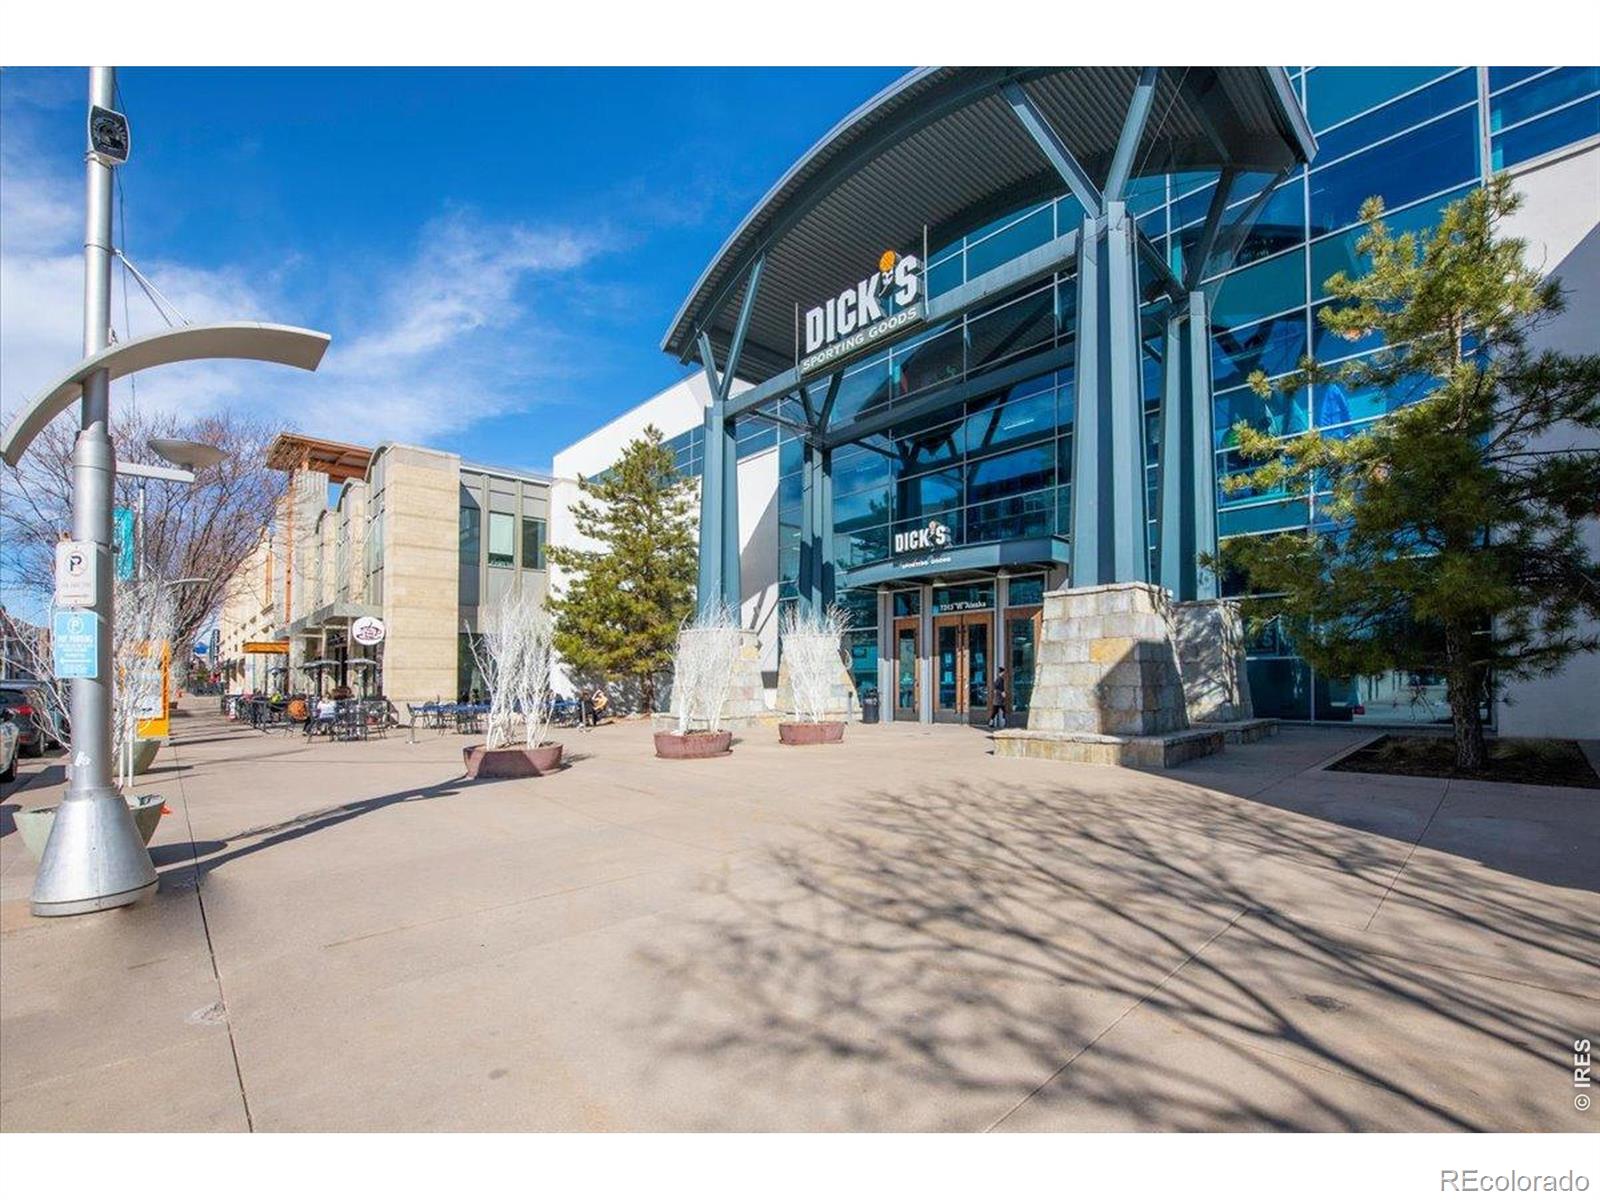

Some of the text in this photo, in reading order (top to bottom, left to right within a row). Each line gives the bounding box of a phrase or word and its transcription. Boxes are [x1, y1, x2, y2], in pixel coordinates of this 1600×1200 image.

[805, 250, 919, 354] DICK'S
[802, 307, 918, 371] SPORTING GOODS
[894, 520, 947, 553] DICK'S
